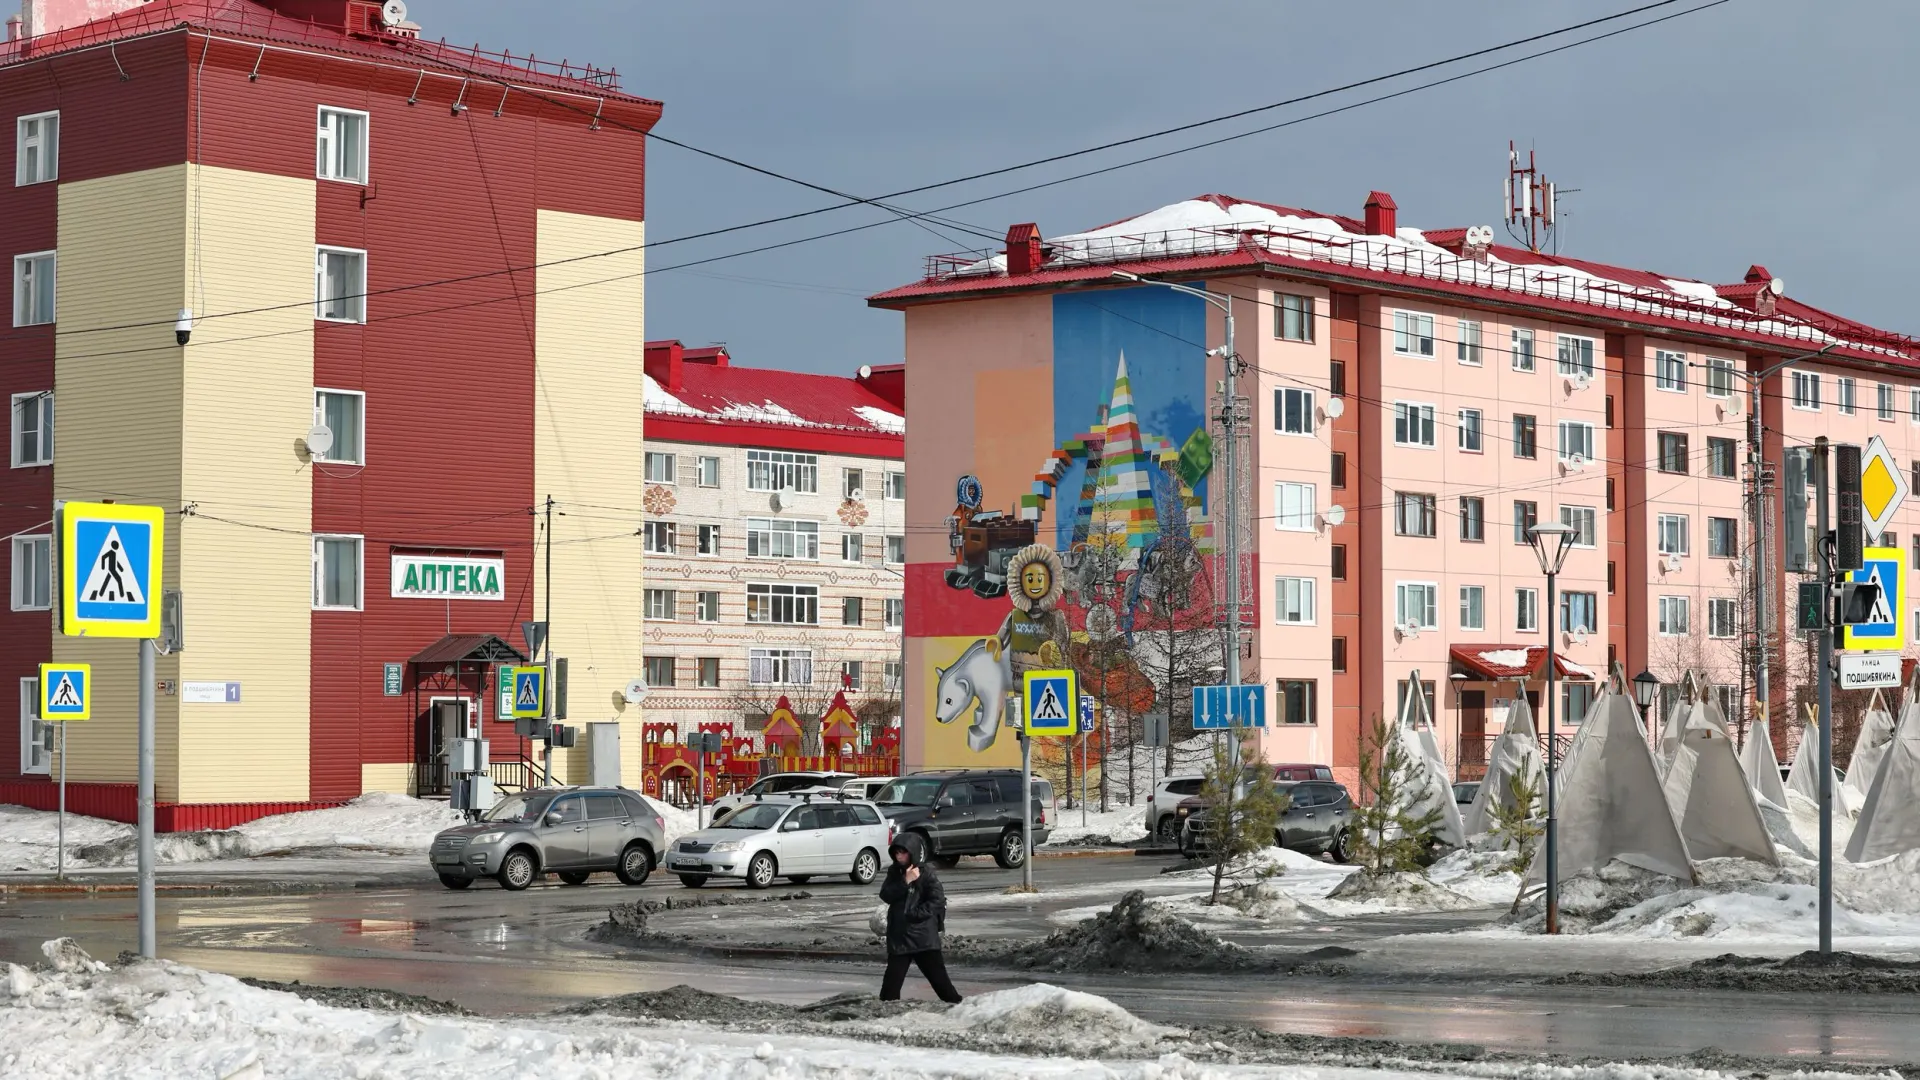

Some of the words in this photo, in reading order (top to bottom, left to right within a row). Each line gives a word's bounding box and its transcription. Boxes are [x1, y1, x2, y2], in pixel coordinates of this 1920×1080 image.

[402, 563, 500, 594] АПТЕКА
[1846, 671, 1896, 685] ПОДШИБЯКИНА
[230, 686, 236, 699] 1
